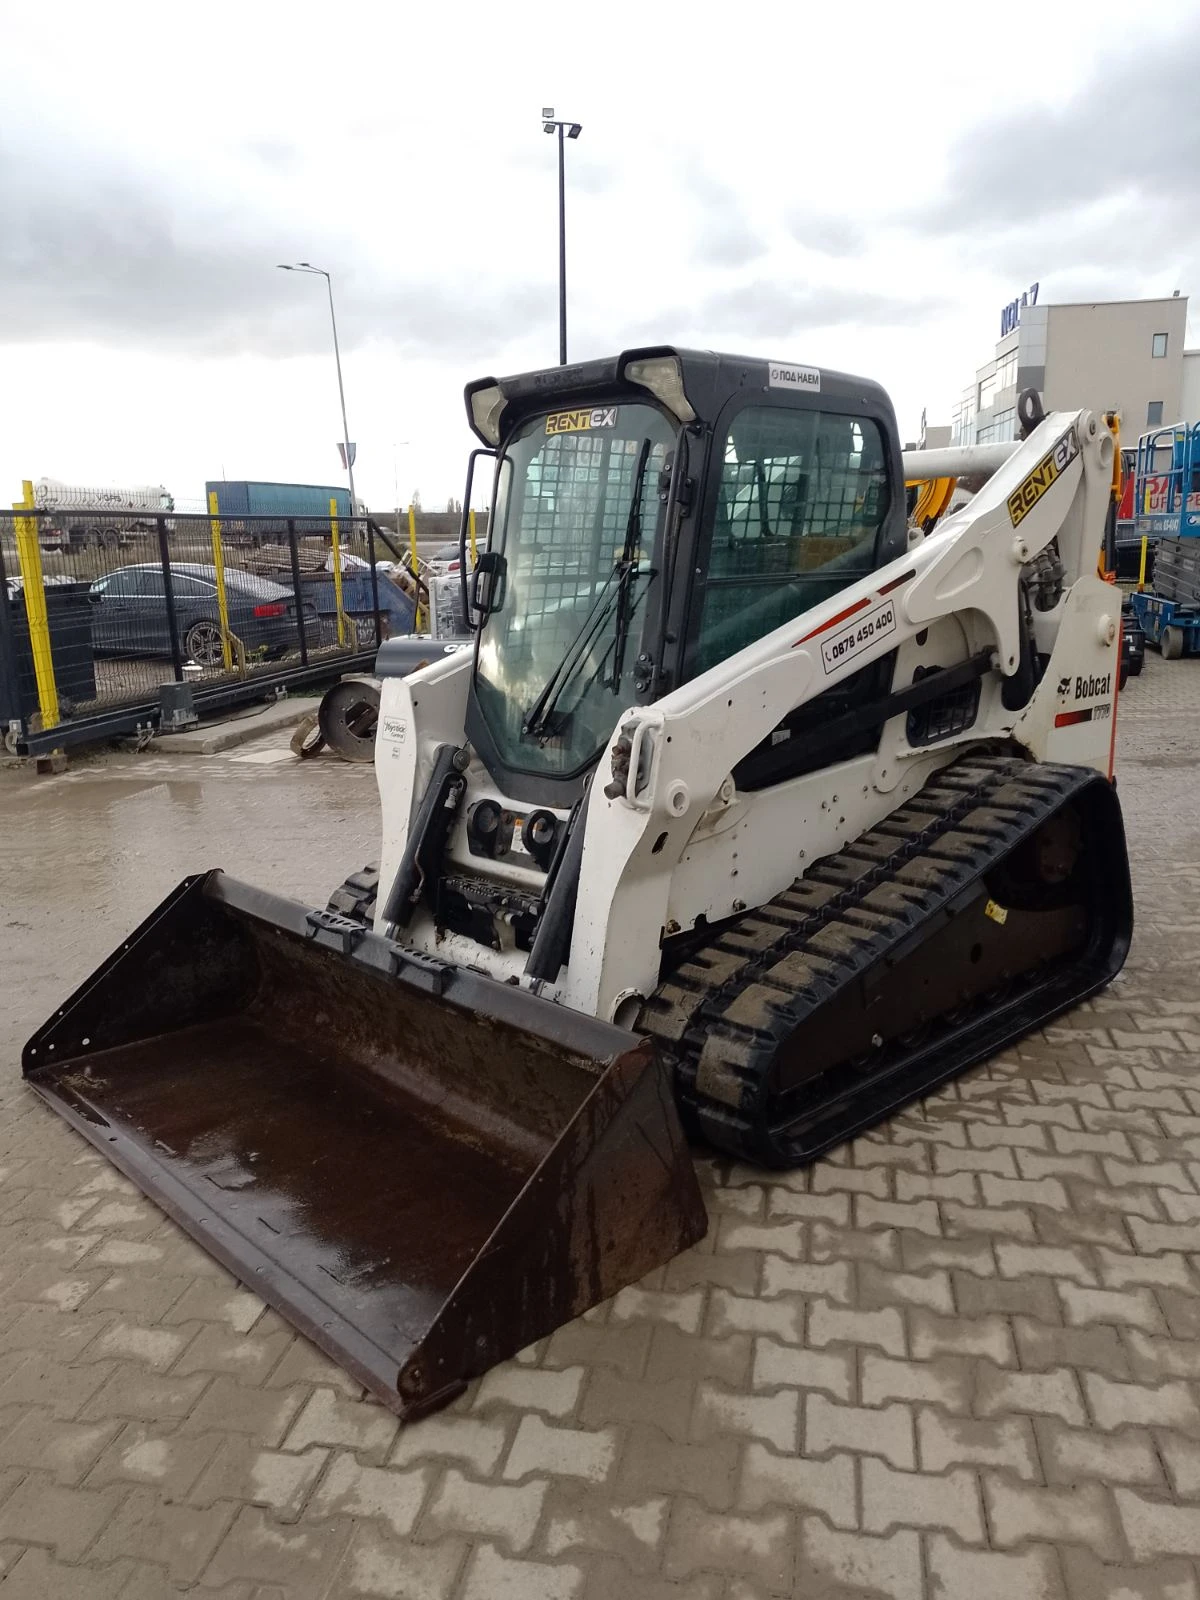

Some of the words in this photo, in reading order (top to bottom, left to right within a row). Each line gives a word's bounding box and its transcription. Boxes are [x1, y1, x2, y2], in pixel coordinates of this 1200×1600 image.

[779, 370, 797, 382] ПОД
[797, 372, 819, 385] НАЕМ
[547, 409, 615, 432] RENTEX
[1010, 431, 1077, 522] RENTEX
[832, 635, 856, 659] 0878
[857, 622, 874, 642] 450
[875, 610, 893, 630] 400
[1075, 672, 1111, 699] Bobcat
